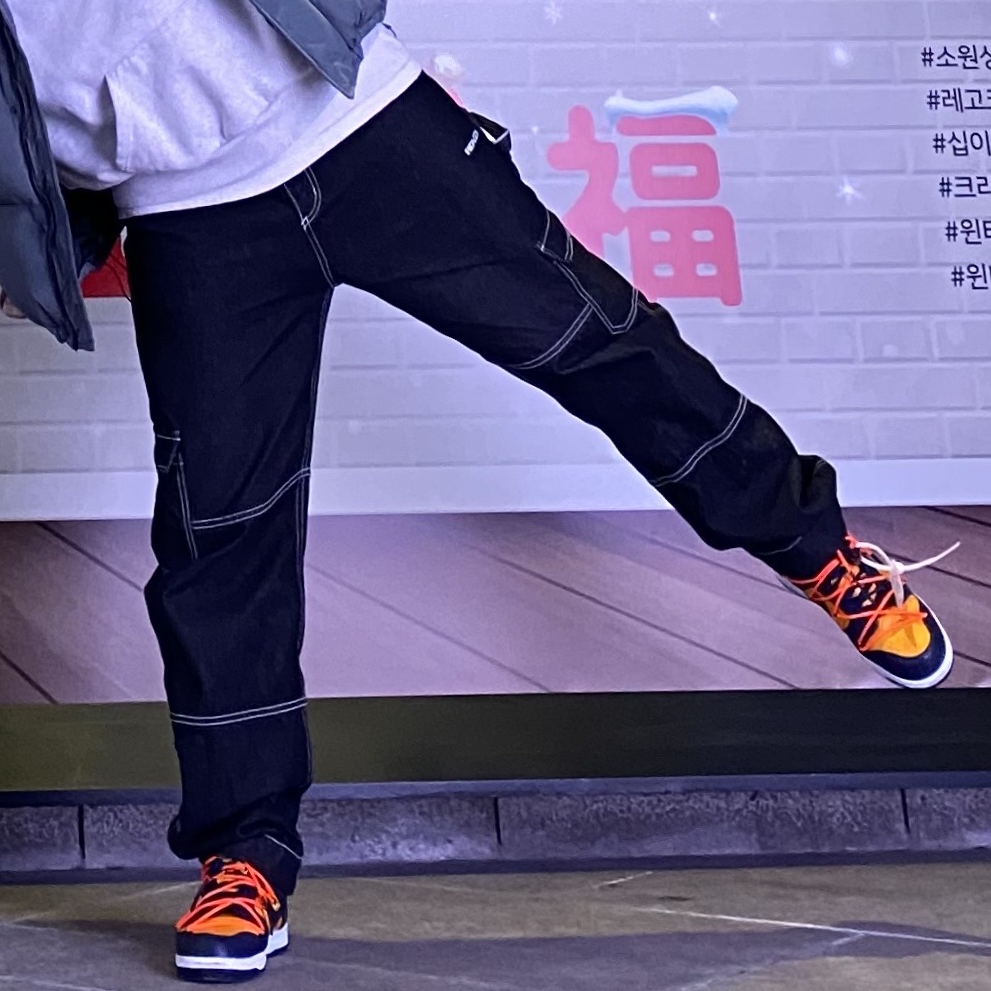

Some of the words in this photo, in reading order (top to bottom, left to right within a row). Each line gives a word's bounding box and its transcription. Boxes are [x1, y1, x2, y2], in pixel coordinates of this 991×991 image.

[927, 87, 991, 113] #레고
[546, 104, 743, 307] 福
[951, 263, 991, 290] #윈
